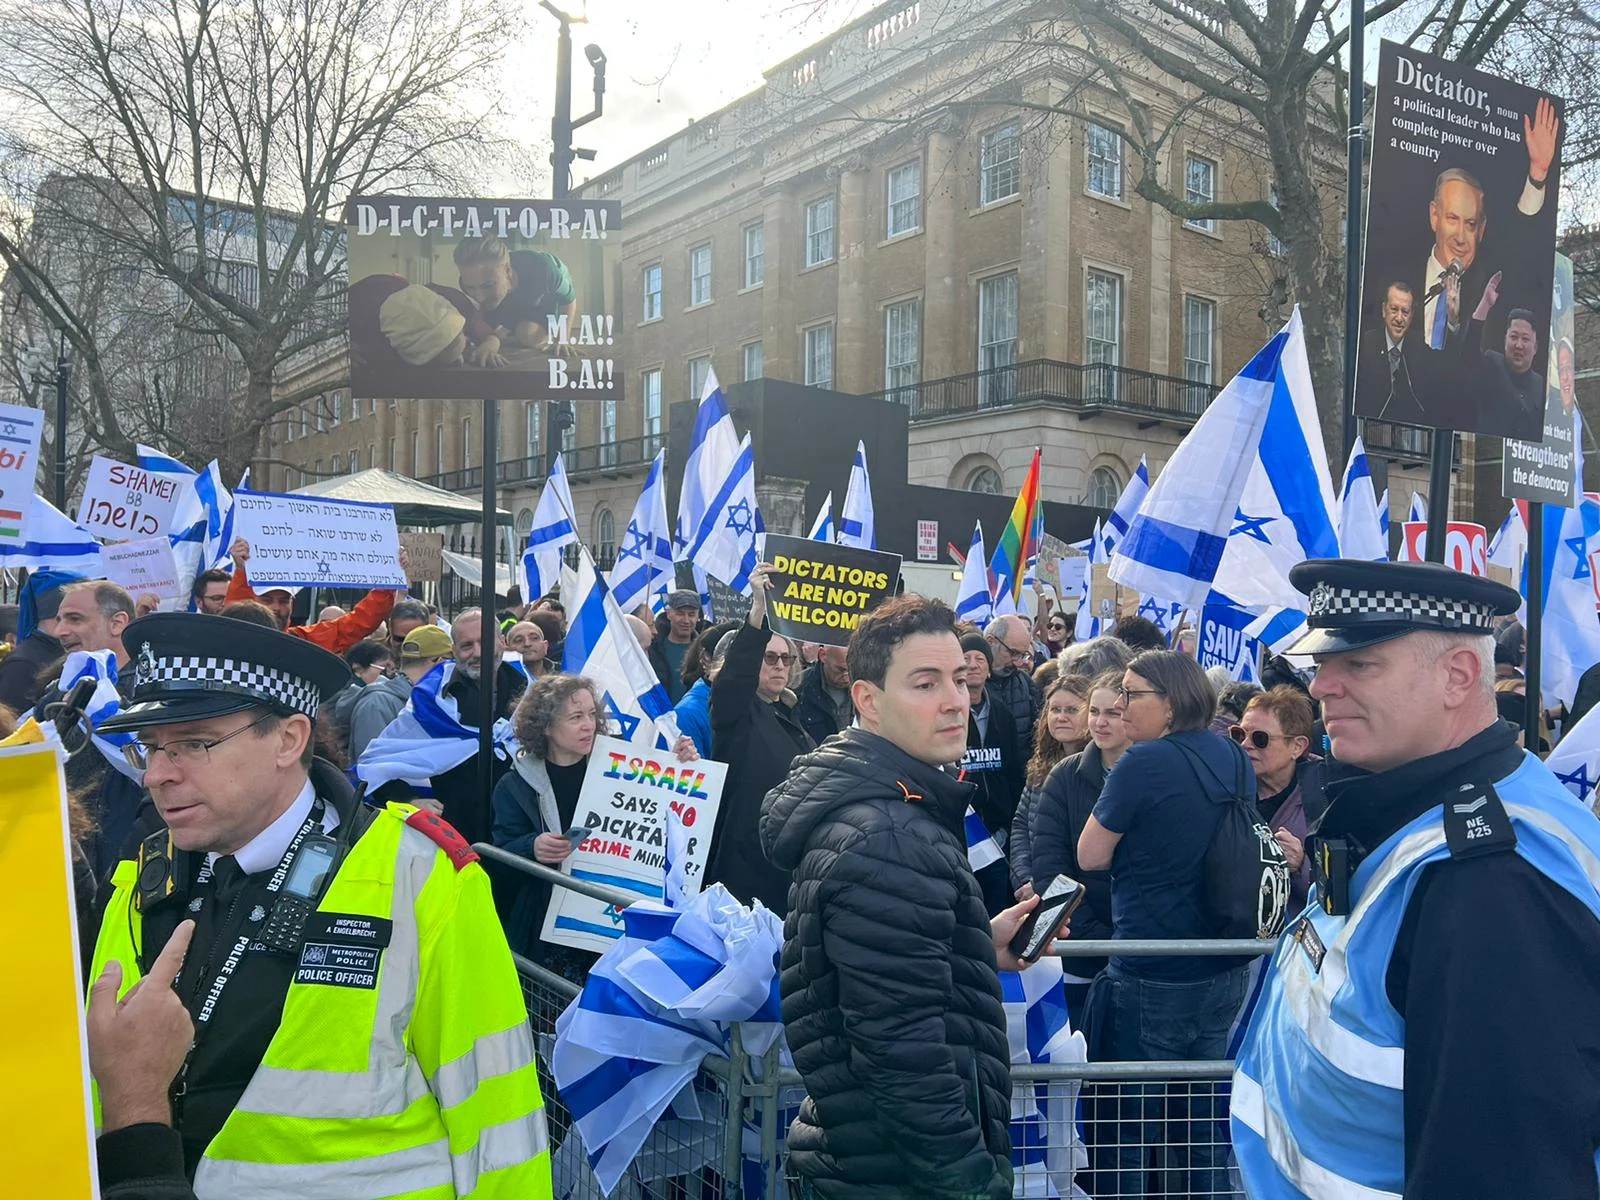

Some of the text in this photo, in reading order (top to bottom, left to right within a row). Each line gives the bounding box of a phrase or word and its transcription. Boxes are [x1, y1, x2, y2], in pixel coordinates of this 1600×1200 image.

[1396, 56, 1519, 121] Dictator, noun
[1393, 95, 1521, 143] a political leader who has
[1390, 136, 1441, 163] a country
[1392, 116, 1498, 156] complete power over
[357, 204, 608, 240] D-I-C-T-A-T-O-R-A!
[546, 314, 614, 346] M.A!!
[548, 358, 614, 390] B.A!!
[109, 466, 177, 503] SHAME!
[1512, 467, 1569, 497] the democracy
[773, 555, 889, 590] DICTATORS
[783, 581, 871, 610] ARE NOT
[603, 751, 709, 801] ISRAEL
[610, 792, 658, 815] SAYS
[642, 817, 658, 825] TO
[1465, 815, 1485, 829] NE
[1466, 824, 1493, 839] 425
[578, 837, 632, 859] CRIME
[336, 918, 371, 929] INSPECTOR
[331, 948, 374, 958] METROPOLITAN
[336, 957, 368, 966] POLICE
[198, 935, 250, 1022] POLICE OFFICER
[297, 969, 374, 986] POLICE OFFICER
